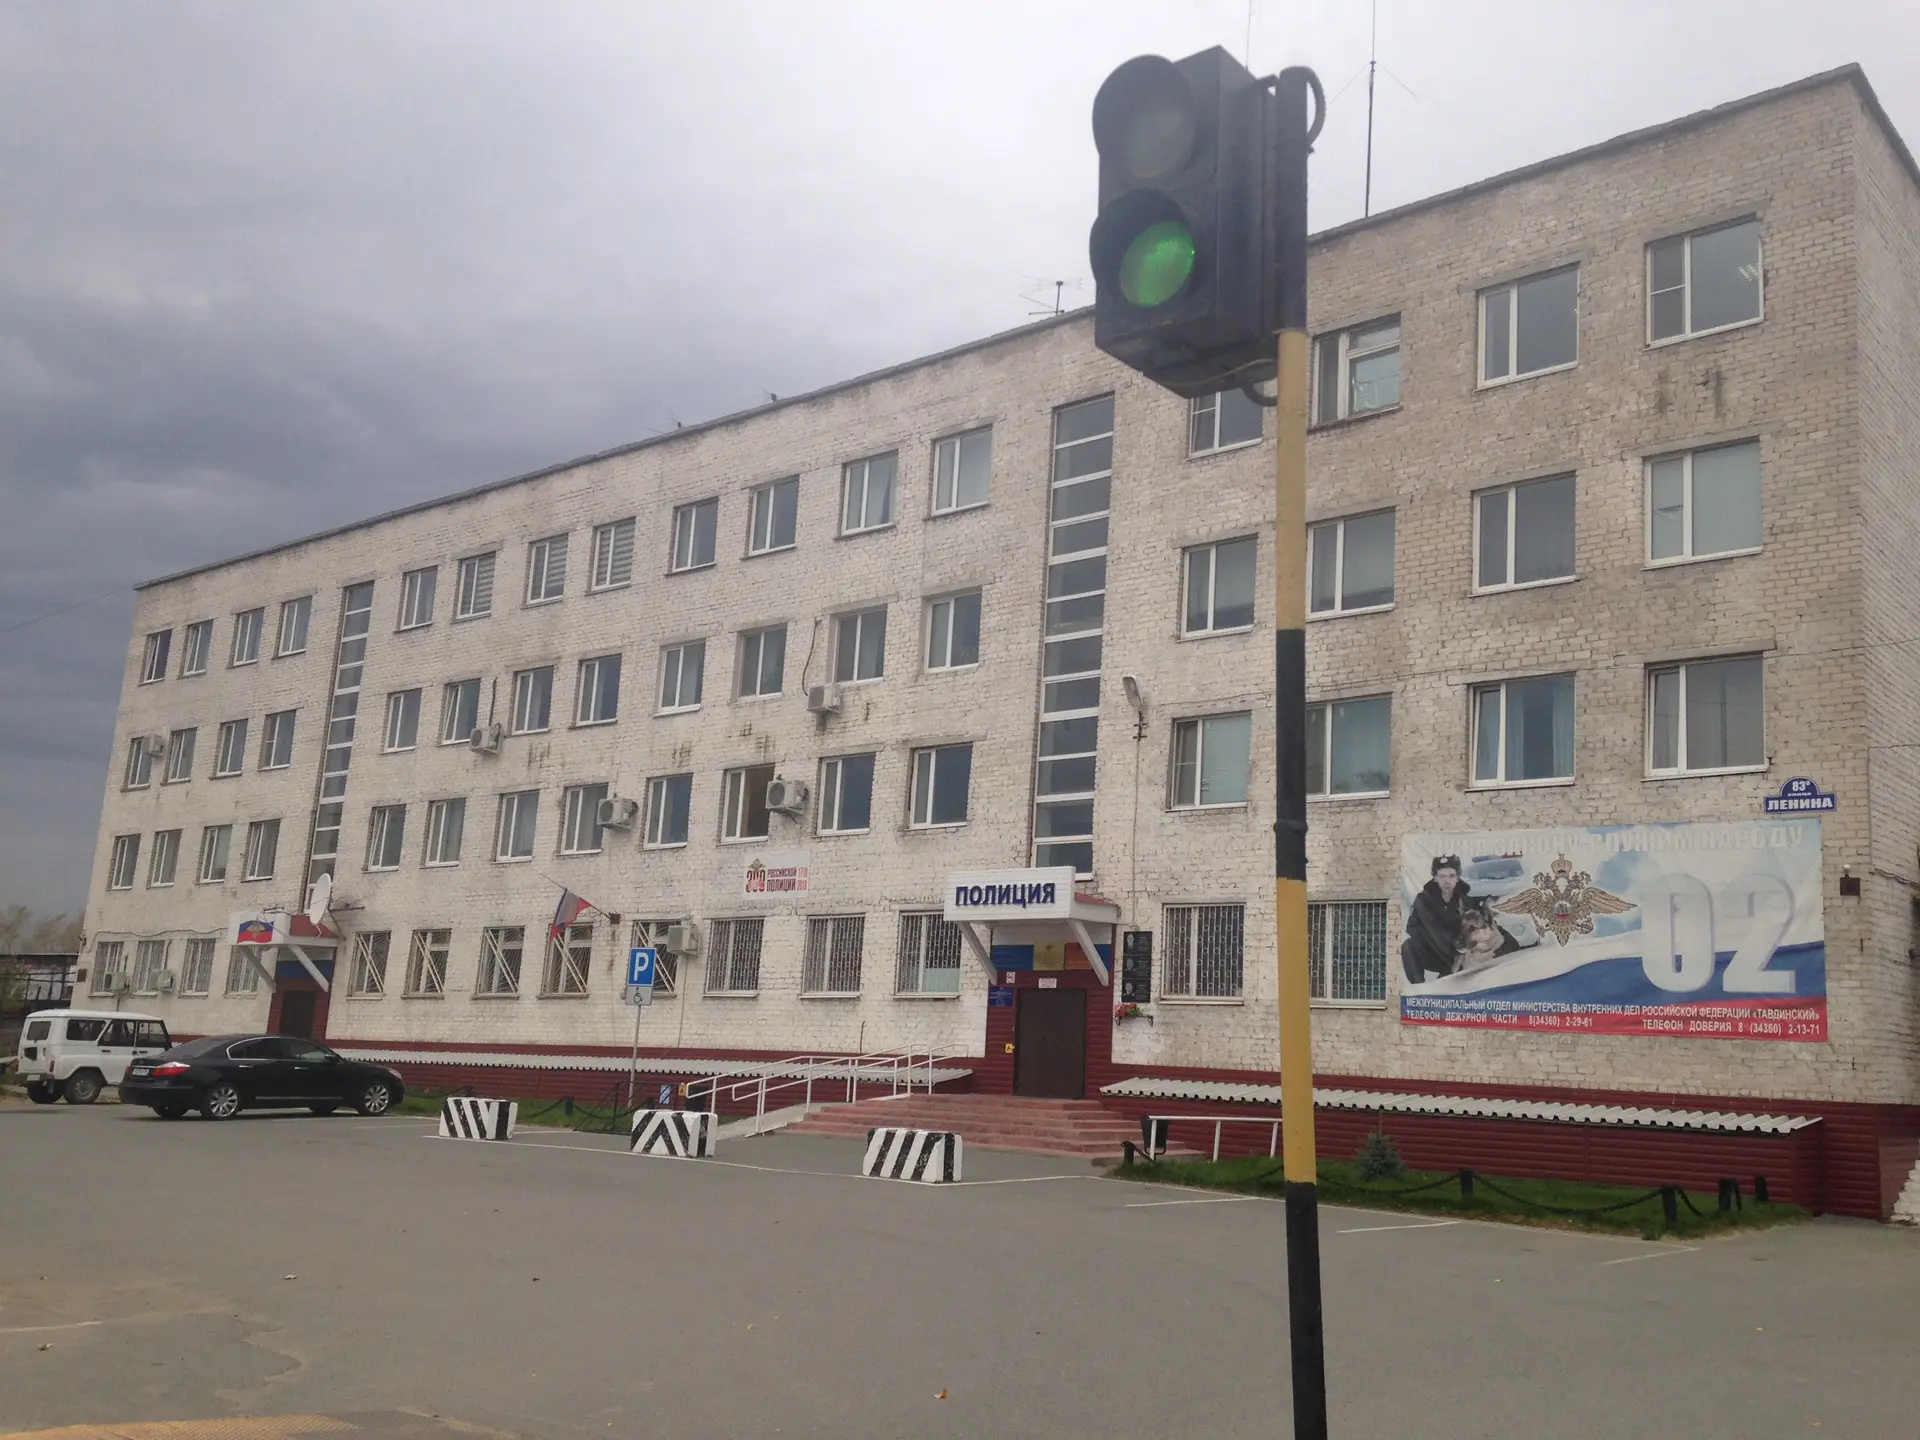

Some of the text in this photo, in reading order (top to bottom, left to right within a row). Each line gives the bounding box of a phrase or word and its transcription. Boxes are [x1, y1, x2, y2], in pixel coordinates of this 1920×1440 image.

[1767, 797, 1833, 810] ЛЕНИНА
[1702, 825, 1804, 851] НАРОДУ
[955, 883, 1055, 908] ПОЛИЦИЯ
[1641, 872, 1797, 993] 02
[1406, 997, 1486, 1010] МЕЖМУНИЦИПАЛЬНЫЙ
[1487, 1000, 1511, 1012] ОТДЕЛ
[1512, 1002, 1571, 1013] МИНИСТЕРСТВА
[1572, 1003, 1623, 1015] ВНУТРЕННИХ
[1624, 1005, 1640, 1016] ДЕЛ
[1642, 1005, 1697, 1017] РОССИЙСКОЙ
[1699, 1007, 1751, 1019] ФЕДЕРАЦИИ
[1406, 1010, 1440, 1021] ТЕЛЕФОН
[1445, 1011, 1487, 1023] ДЕЖУРНОЙ
[1492, 1014, 1518, 1024] ЧАСТИ
[1642, 1019, 1820, 1036] ТЕЛЕФОН ДОВЕРИЯ 8 (34360) 2-13-71
